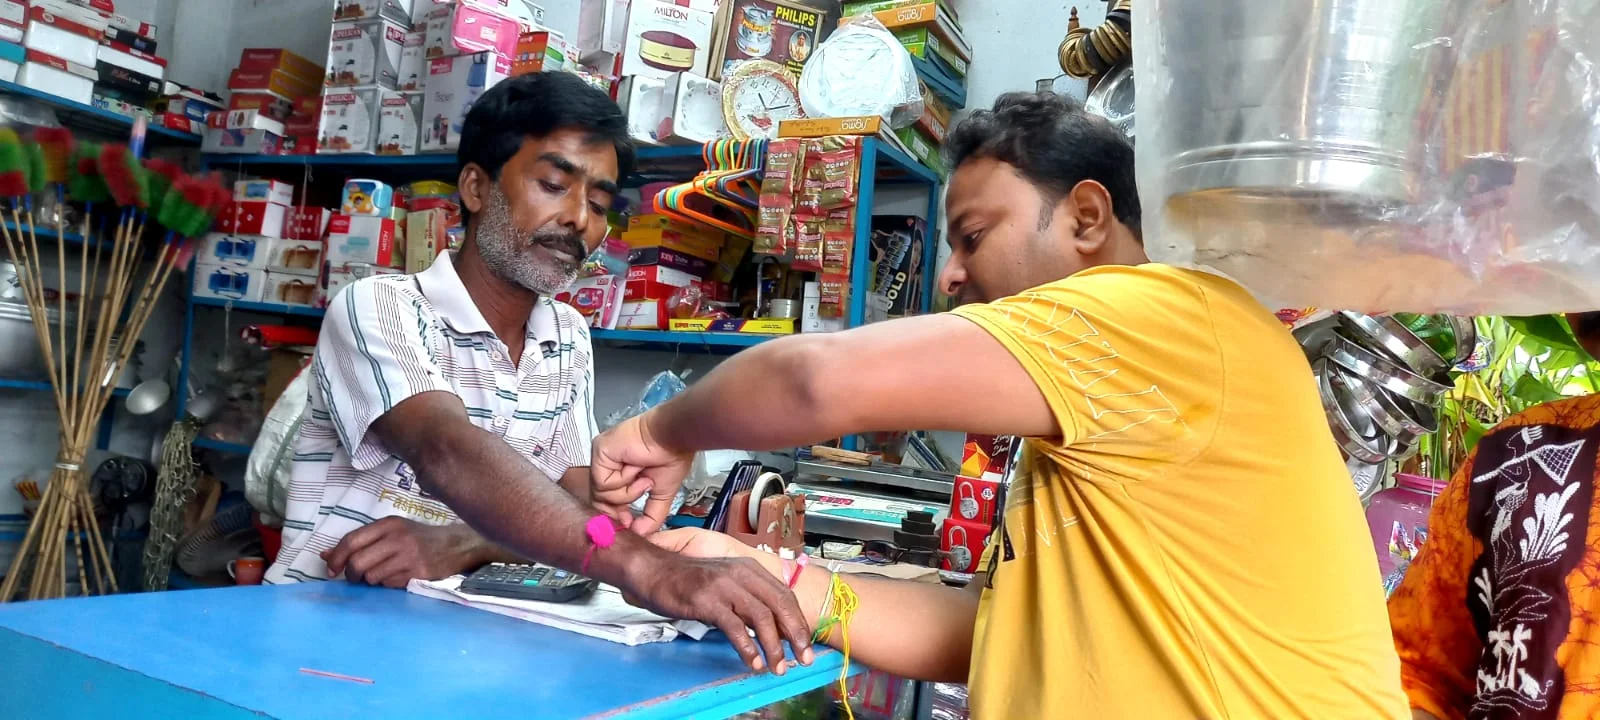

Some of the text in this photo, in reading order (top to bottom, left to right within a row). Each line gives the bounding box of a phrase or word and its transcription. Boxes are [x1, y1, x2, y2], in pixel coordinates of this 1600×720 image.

[655, 7, 688, 20] MILTON
[775, 6, 816, 26] PHILIPS
[841, 117, 872, 131] Sigma
[378, 488, 449, 524] Fashion
